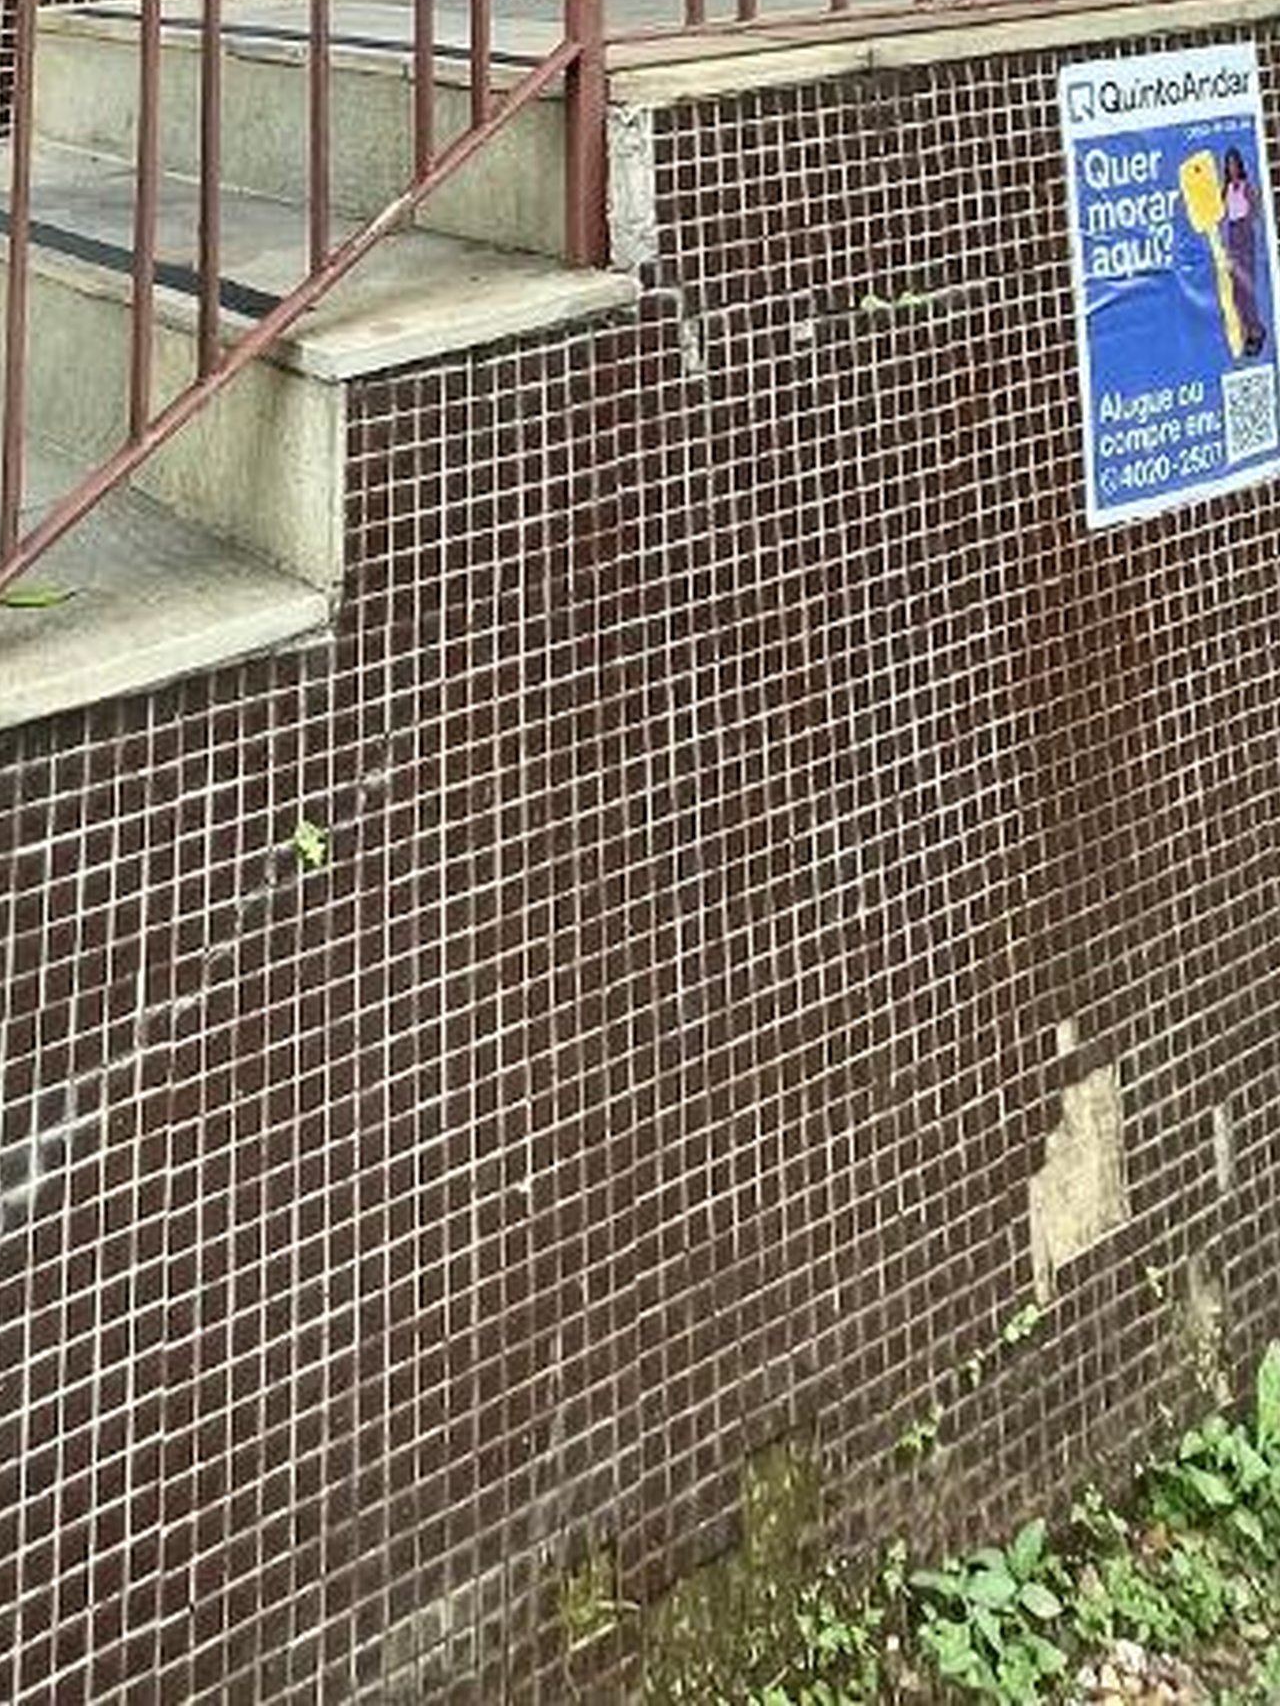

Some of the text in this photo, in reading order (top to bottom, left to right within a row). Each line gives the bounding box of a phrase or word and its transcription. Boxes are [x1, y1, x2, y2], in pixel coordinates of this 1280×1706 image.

[1098, 67, 1252, 114] QuintoAndar
[1083, 147, 1163, 191] Quer
[1087, 189, 1180, 235] morar
[1091, 223, 1175, 278] aqui?
[1099, 382, 1205, 424] Alugue ou
[1099, 418, 1182, 458] compre
